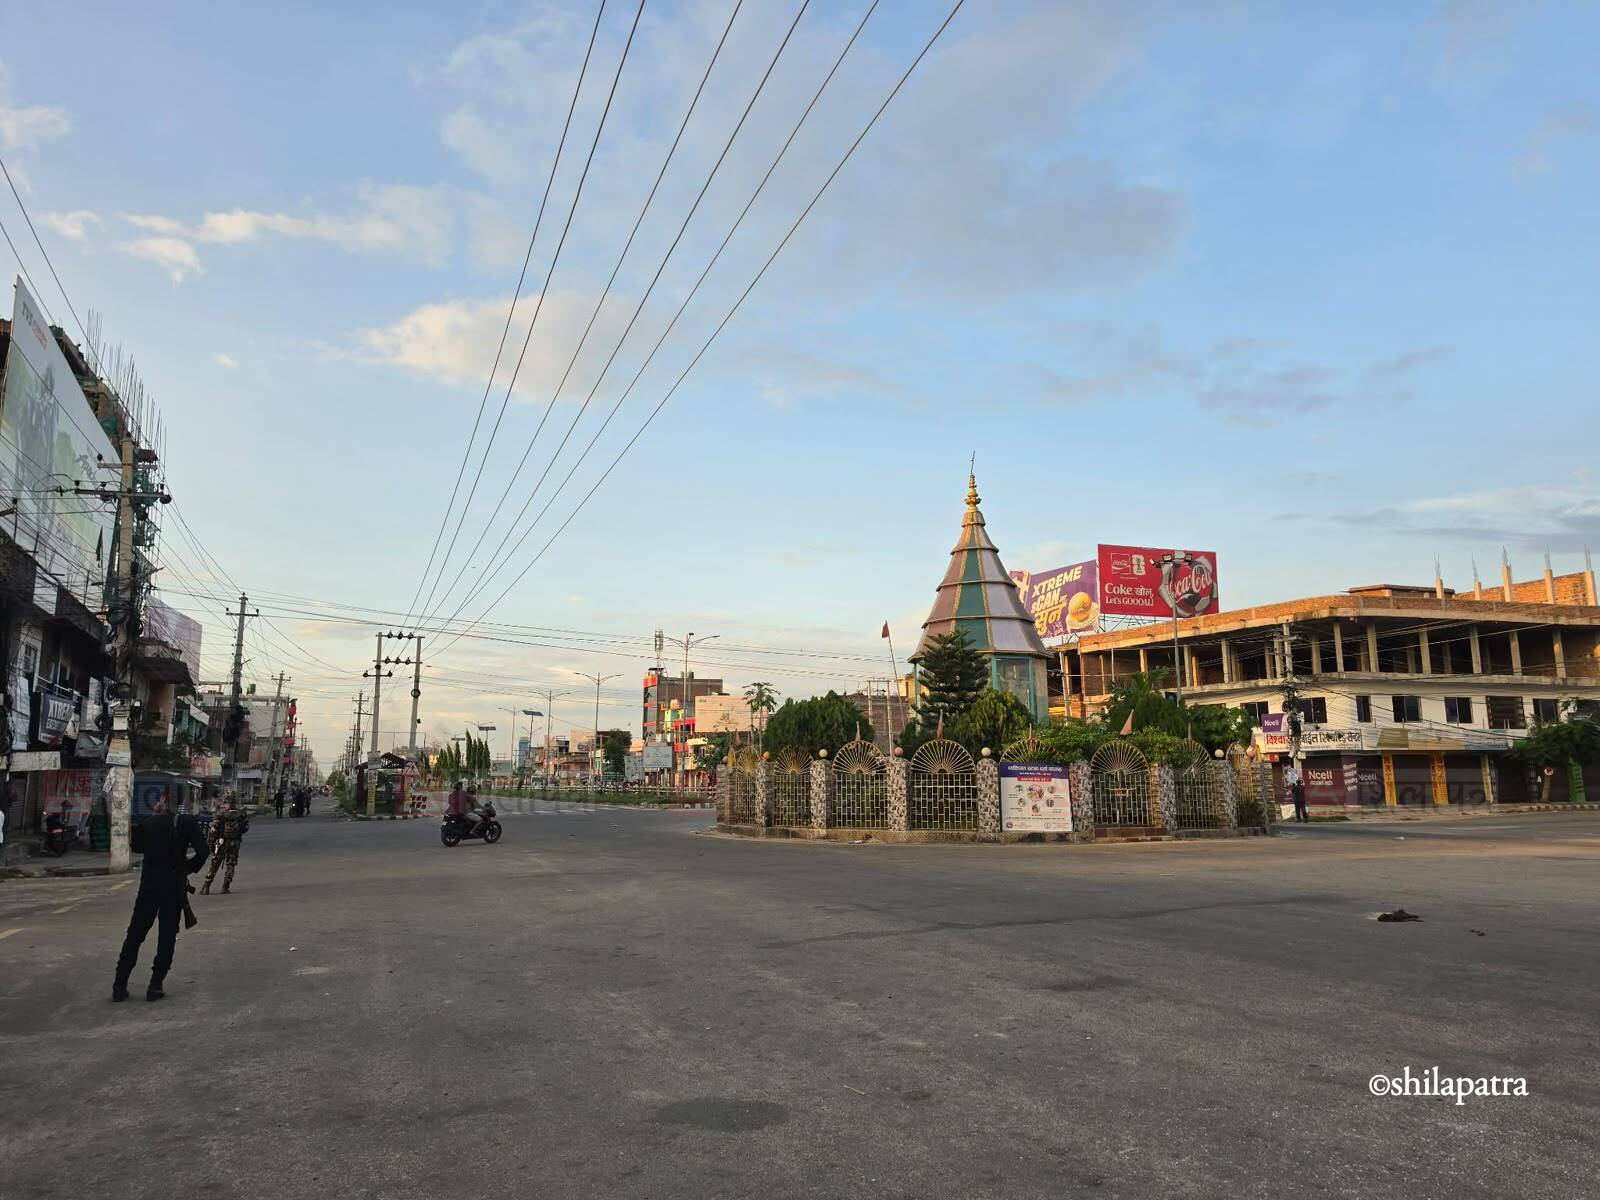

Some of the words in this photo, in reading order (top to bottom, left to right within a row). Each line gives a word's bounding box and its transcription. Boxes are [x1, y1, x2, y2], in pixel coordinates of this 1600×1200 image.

[1031, 566, 1083, 598] XTREME
[1104, 582, 1133, 595] Coke
[1308, 769, 1333, 780] Ncell
[1358, 772, 1377, 781] Ncell
